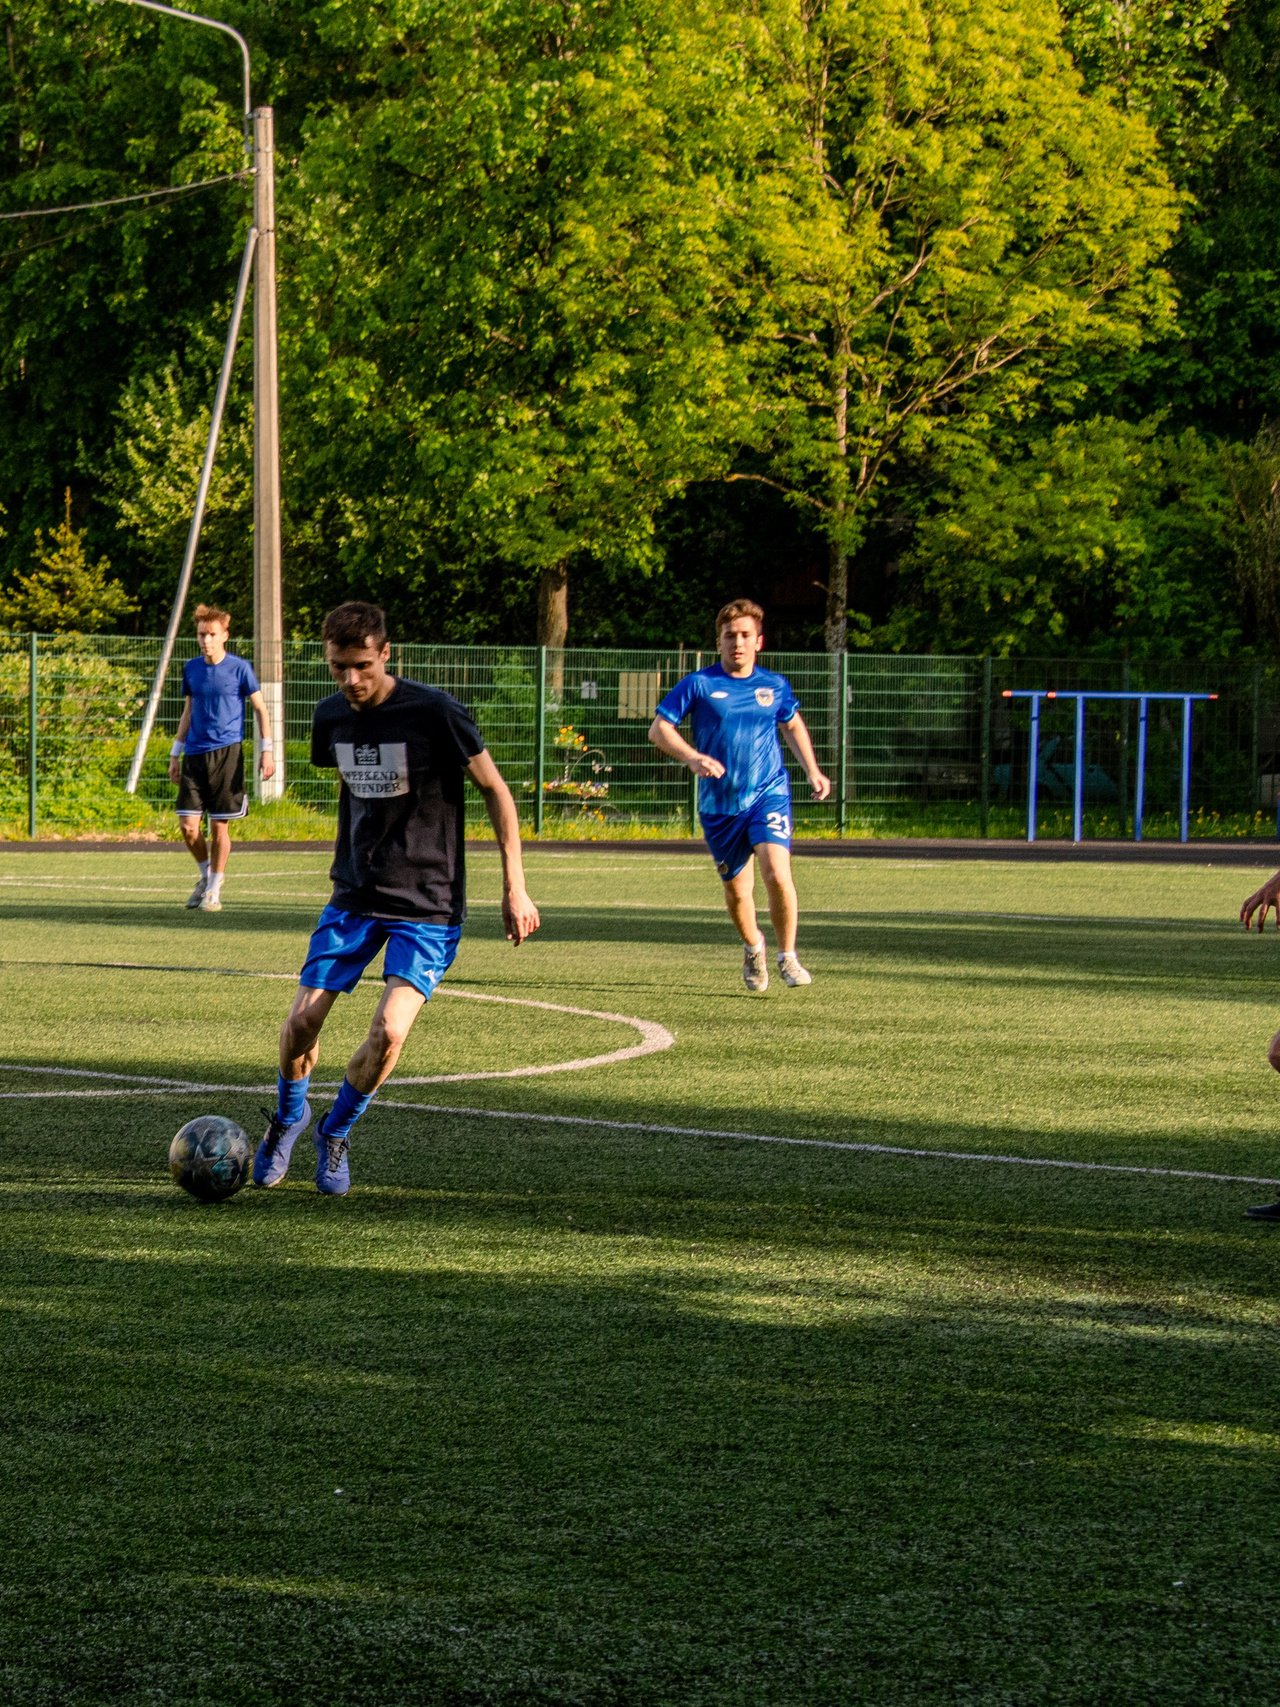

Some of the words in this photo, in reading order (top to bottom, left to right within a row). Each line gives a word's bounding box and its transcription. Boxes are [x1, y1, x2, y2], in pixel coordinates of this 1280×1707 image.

[342, 770, 399, 781] WEEKEND
[348, 782, 401, 794] FFENDER
[766, 811, 791, 837] 21
